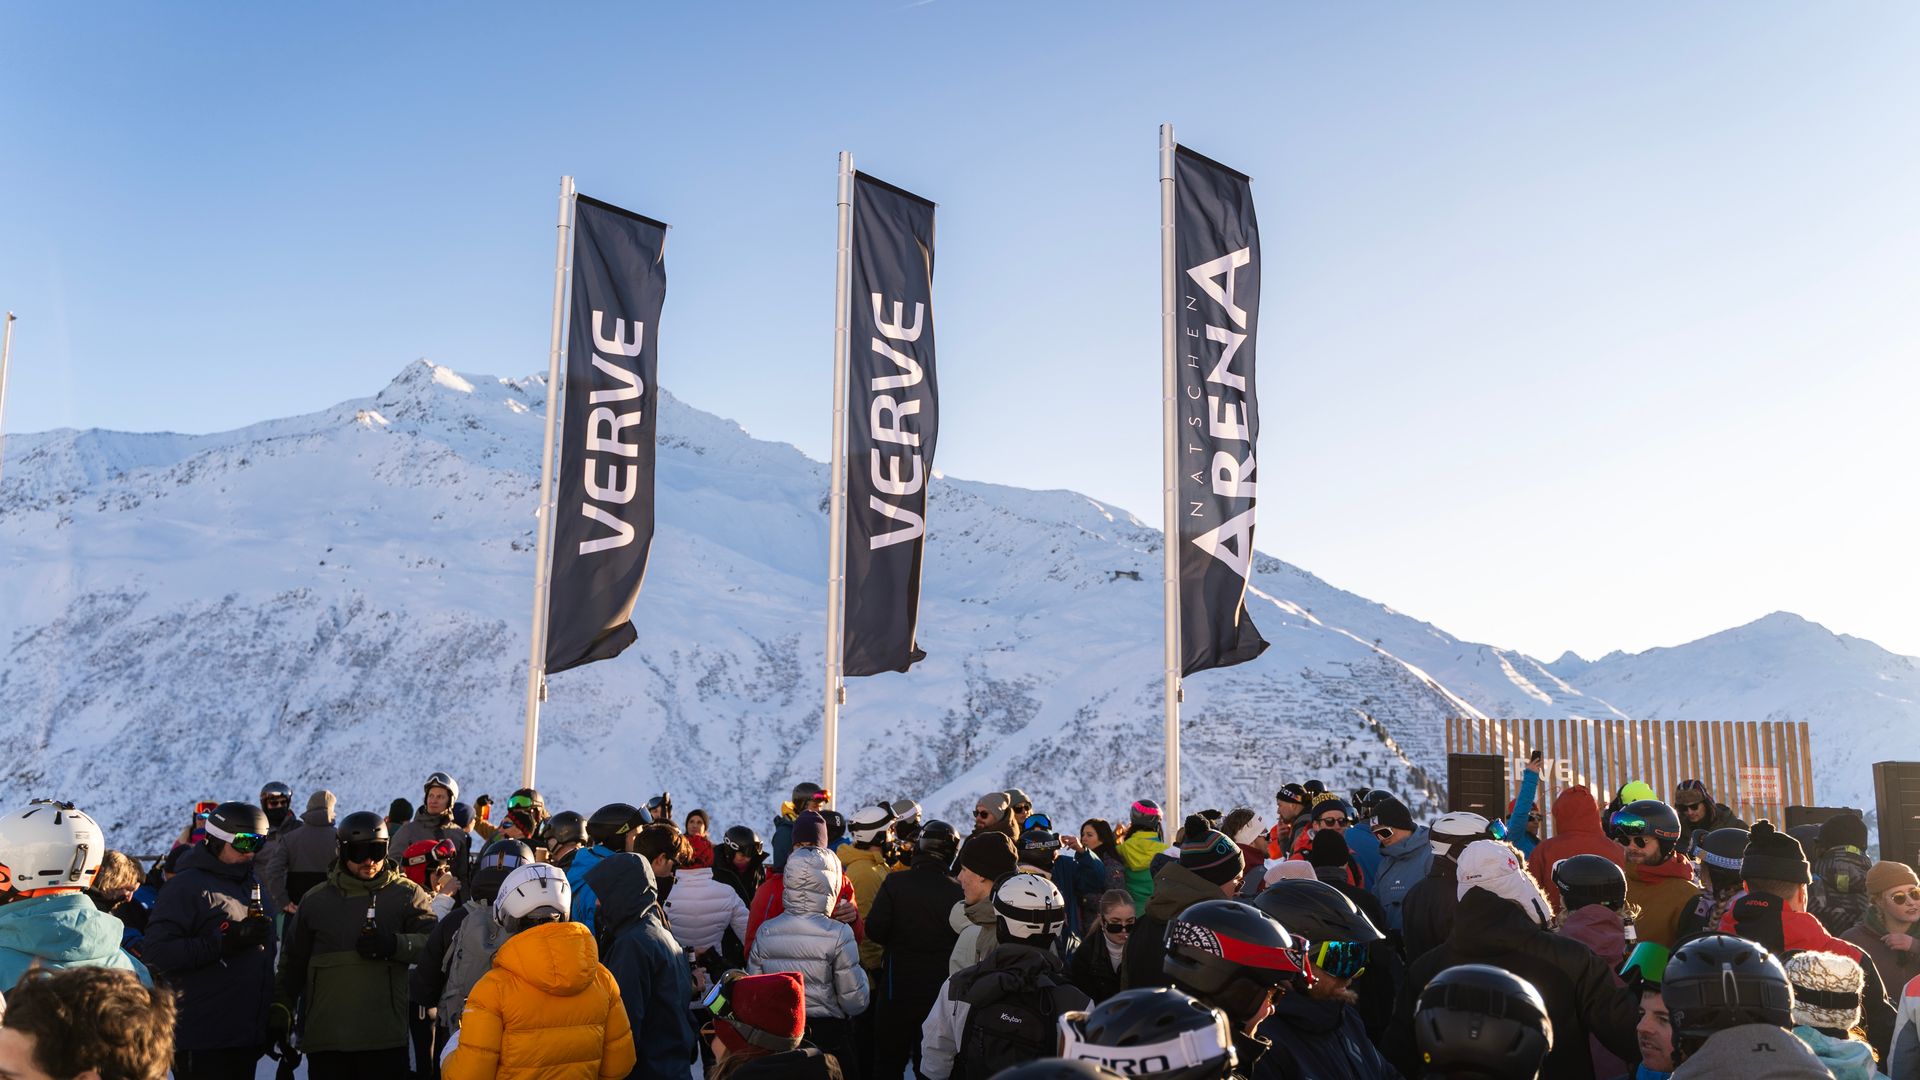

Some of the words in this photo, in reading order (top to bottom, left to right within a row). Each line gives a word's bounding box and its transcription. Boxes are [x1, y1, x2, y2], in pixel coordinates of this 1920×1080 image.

[579, 310, 644, 555] VERVE
[870, 292, 925, 550] VERVE
[1186, 295, 1204, 517] NATSCHEN
[1186, 246, 1258, 580] ARENA
